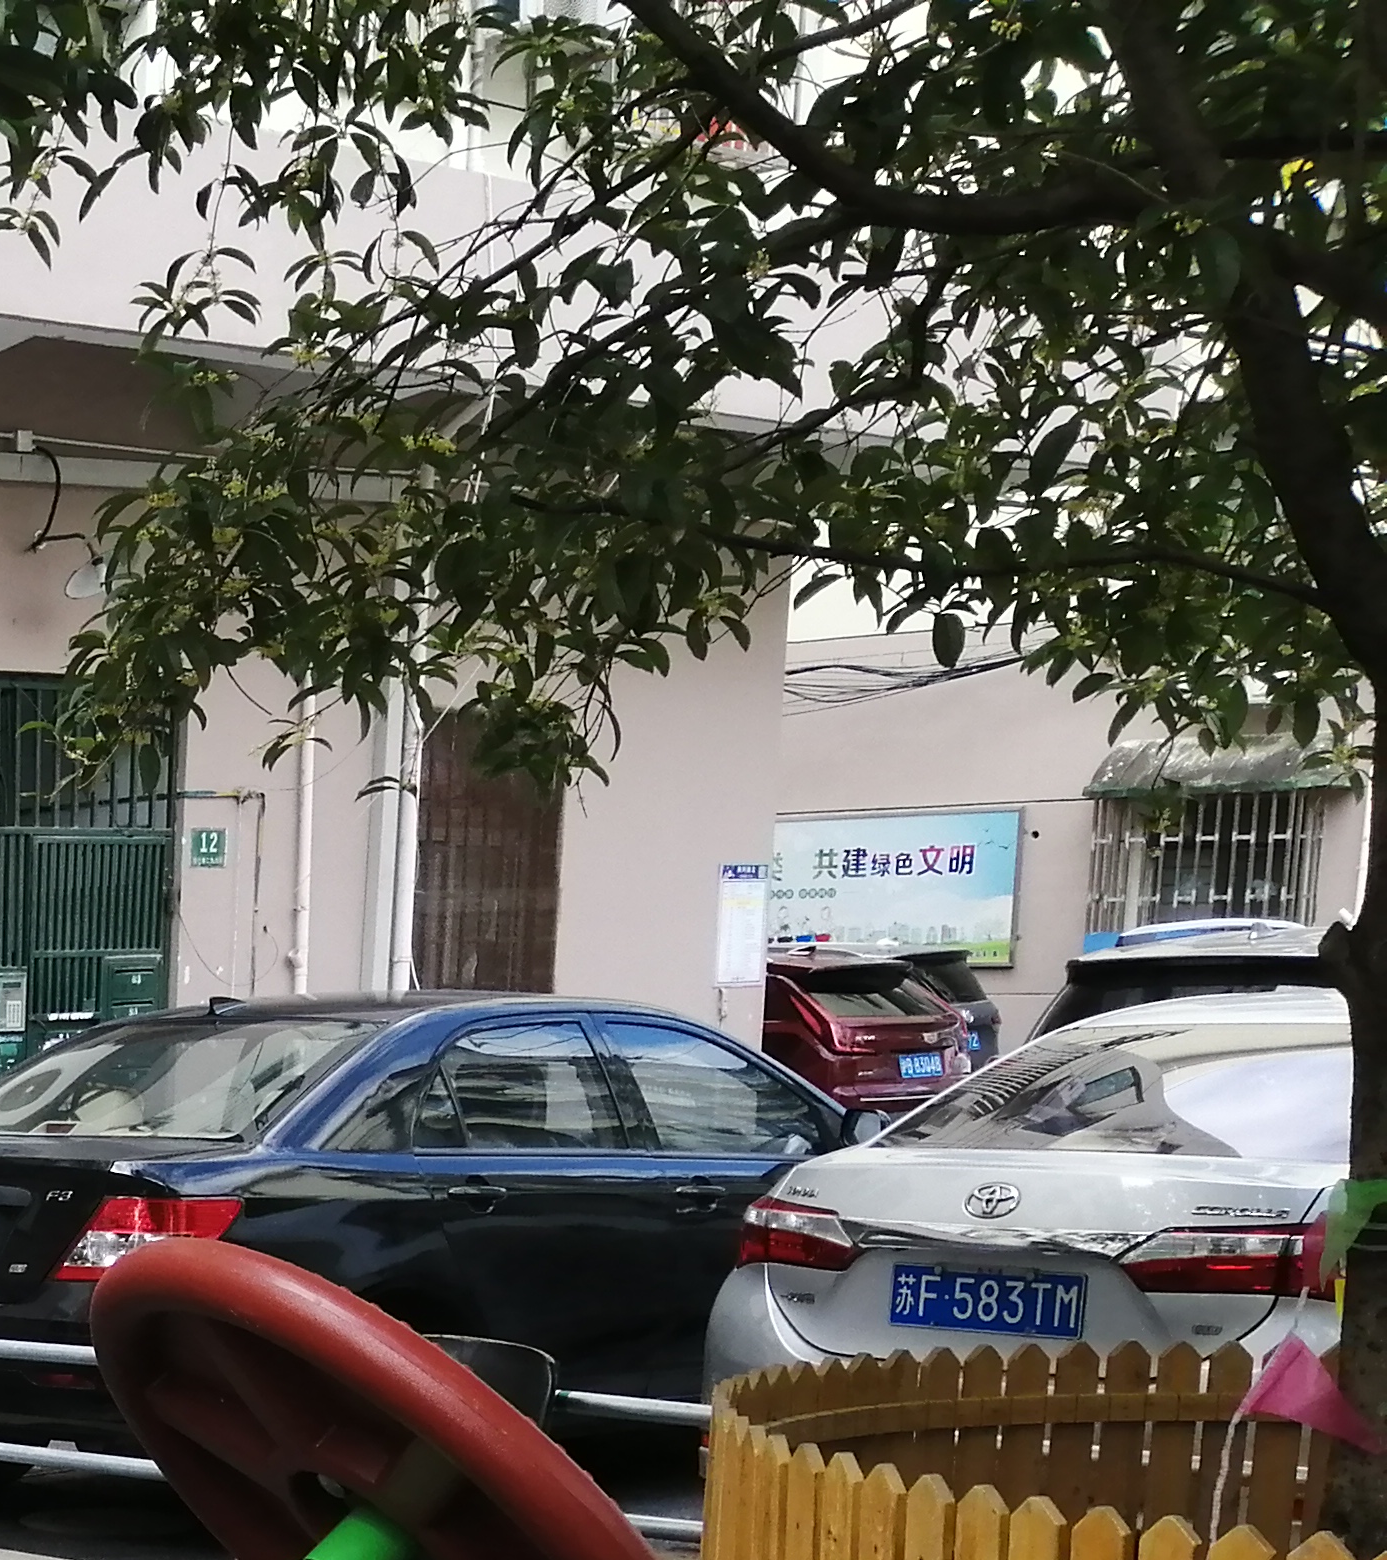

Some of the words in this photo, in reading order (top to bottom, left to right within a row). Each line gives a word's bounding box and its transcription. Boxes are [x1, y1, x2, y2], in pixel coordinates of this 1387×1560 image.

[199, 832, 218, 853] 12
[812, 844, 976, 880] 共建绿色文明
[45, 1190, 74, 1201] F3
[894, 1273, 1081, 1328] 苏F·583TM
